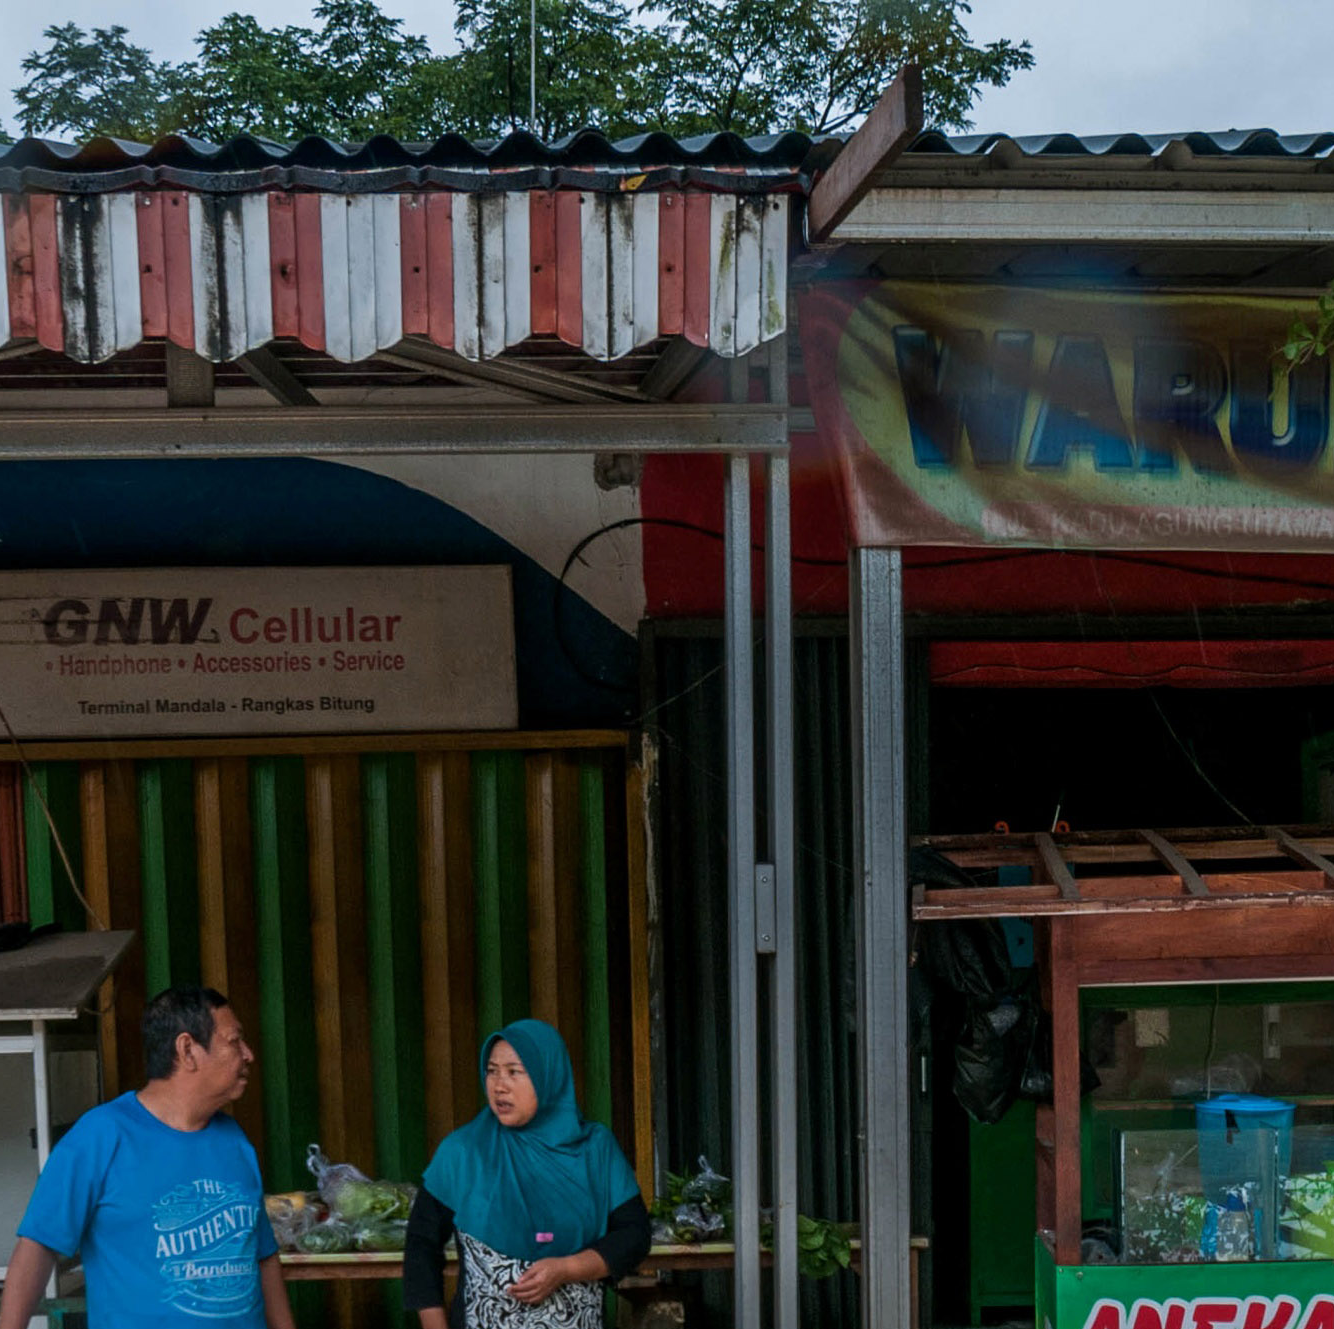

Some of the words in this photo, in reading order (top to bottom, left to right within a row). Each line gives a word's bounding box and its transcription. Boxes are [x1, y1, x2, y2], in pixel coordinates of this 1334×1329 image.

[1138, 510, 1232, 537] AGUNG
[228, 606, 402, 643] Cellular
[59, 653, 172, 677] Handphone
[192, 651, 311, 673] Accessories
[333, 650, 405, 671] Service
[78, 699, 151, 715] Terminal
[155, 698, 227, 714] Mandala
[242, 697, 315, 715] Rangkas
[319, 696, 375, 715] Bitung
[191, 1178, 226, 1194] THE
